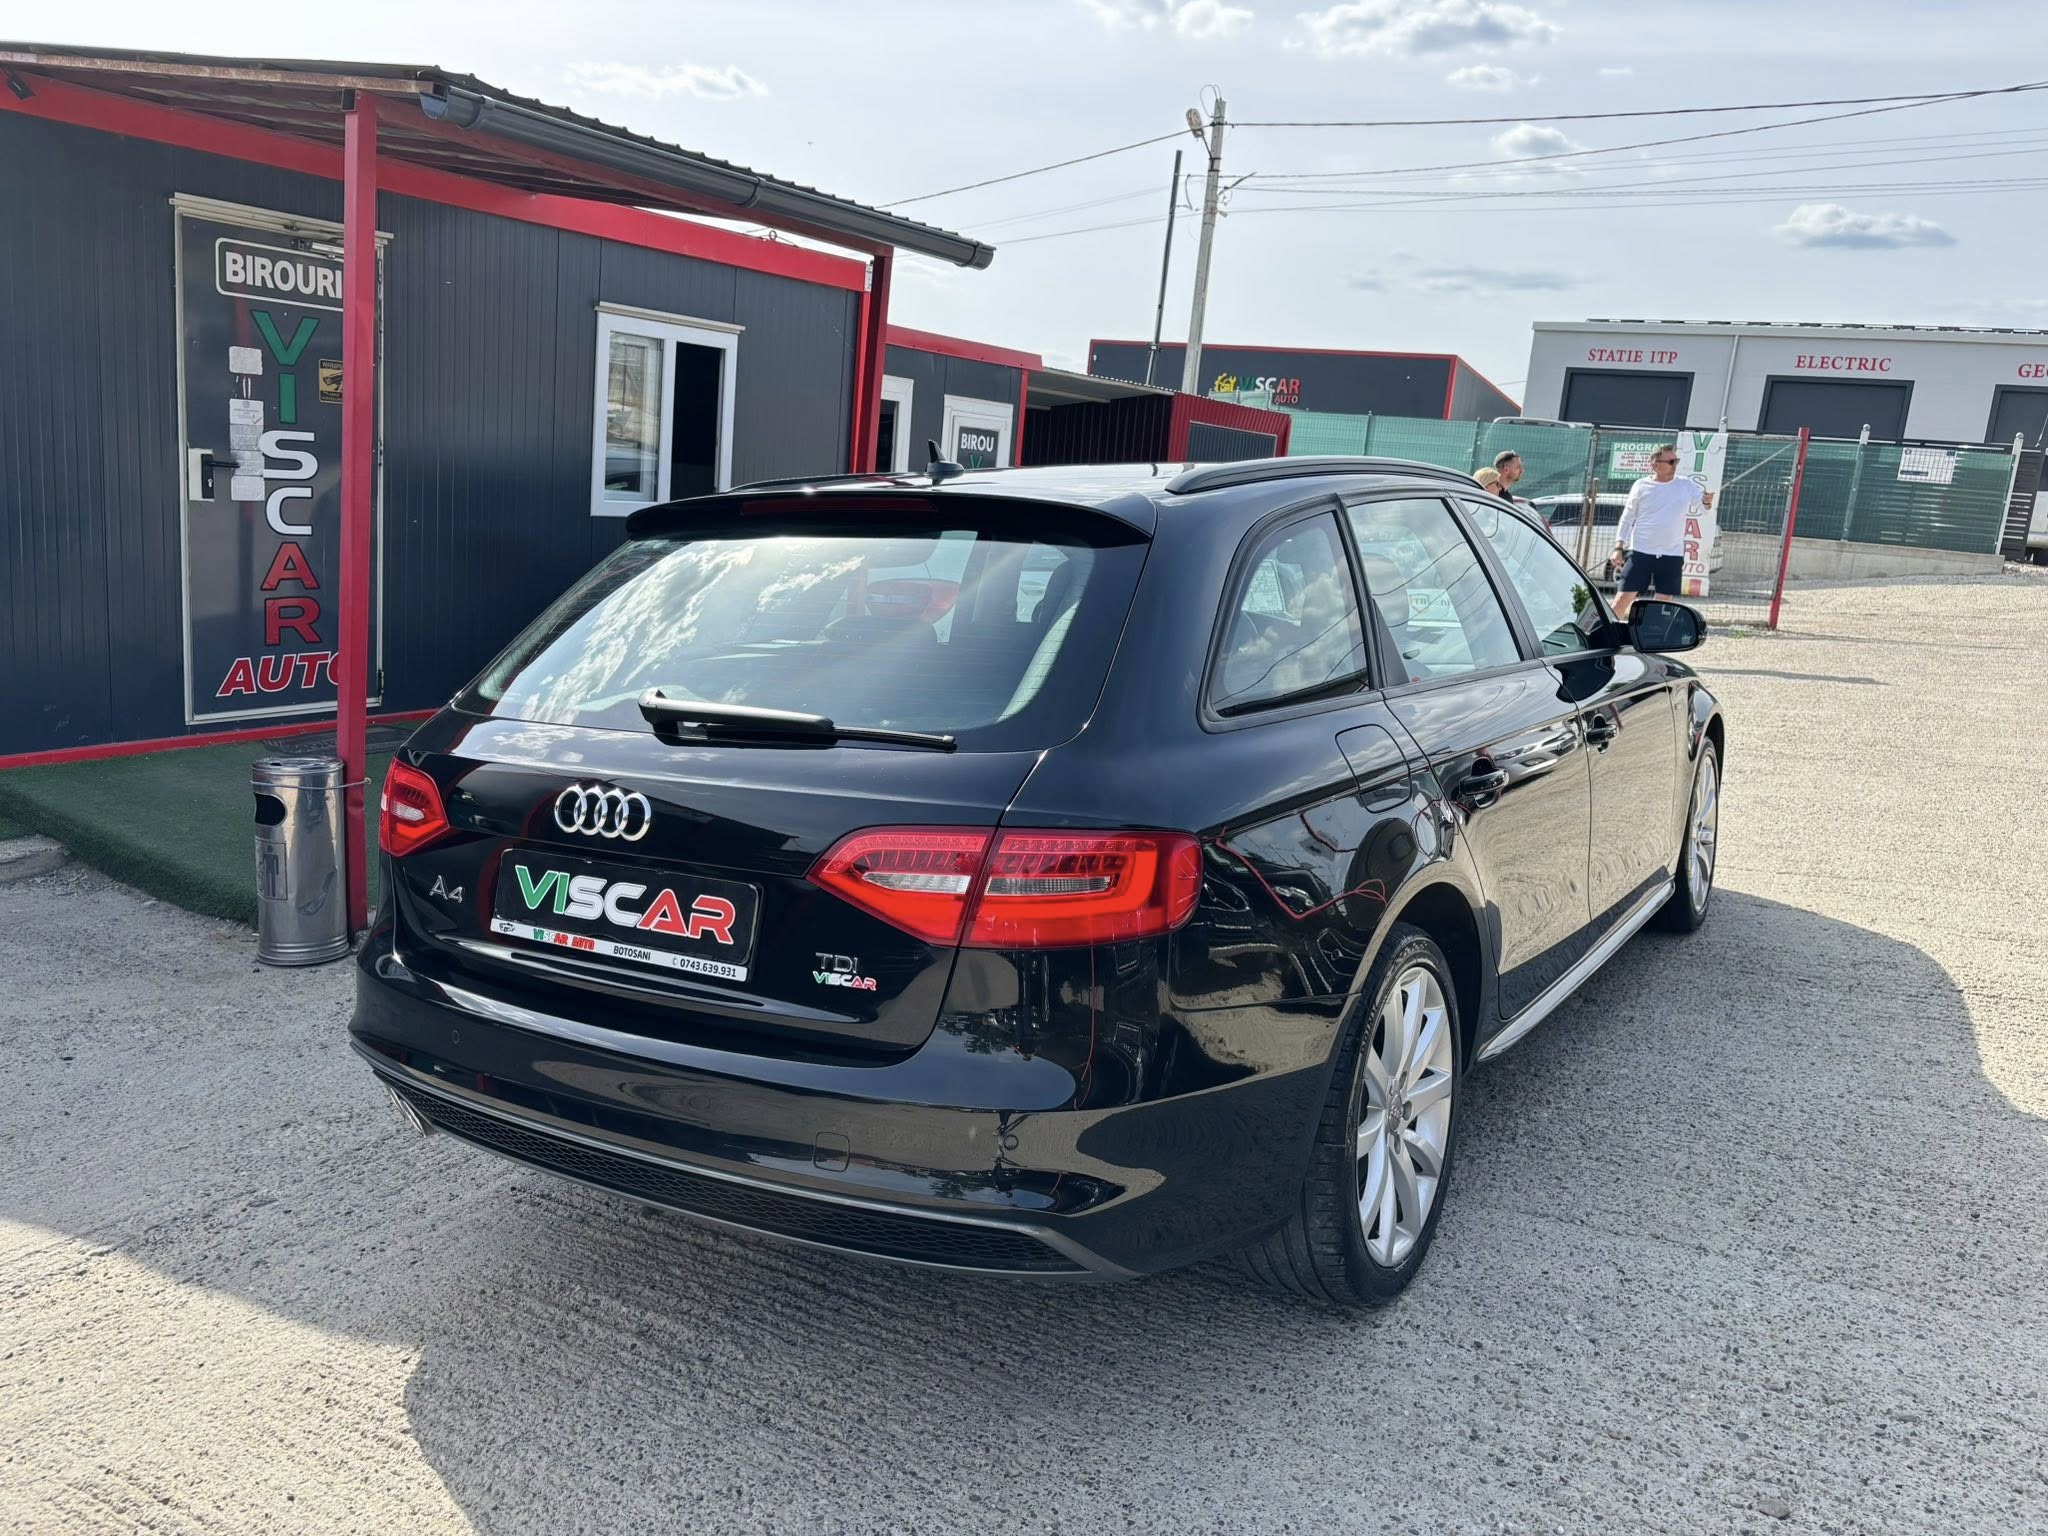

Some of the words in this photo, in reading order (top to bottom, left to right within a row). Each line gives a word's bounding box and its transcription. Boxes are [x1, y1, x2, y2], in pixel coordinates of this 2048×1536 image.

[225, 251, 343, 299] BIROURI
[1588, 348, 1643, 363] STATIE
[1650, 351, 1678, 364] ITP
[1795, 355, 1892, 372] ELECTRIC
[2017, 363, 2048, 378] GE
[1240, 376, 1301, 394] VISCAR
[1274, 395, 1299, 405] AUTO
[961, 433, 994, 452] BIROU
[1614, 443, 1662, 451] PROGRA
[429, 875, 463, 903] A4
[515, 865, 736, 945] VISCAR
[613, 945, 651, 961] BOTOSANI
[680, 958, 737, 978] 0743.639.931
[815, 952, 858, 974] TDI
[812, 970, 877, 991] VISCAR
